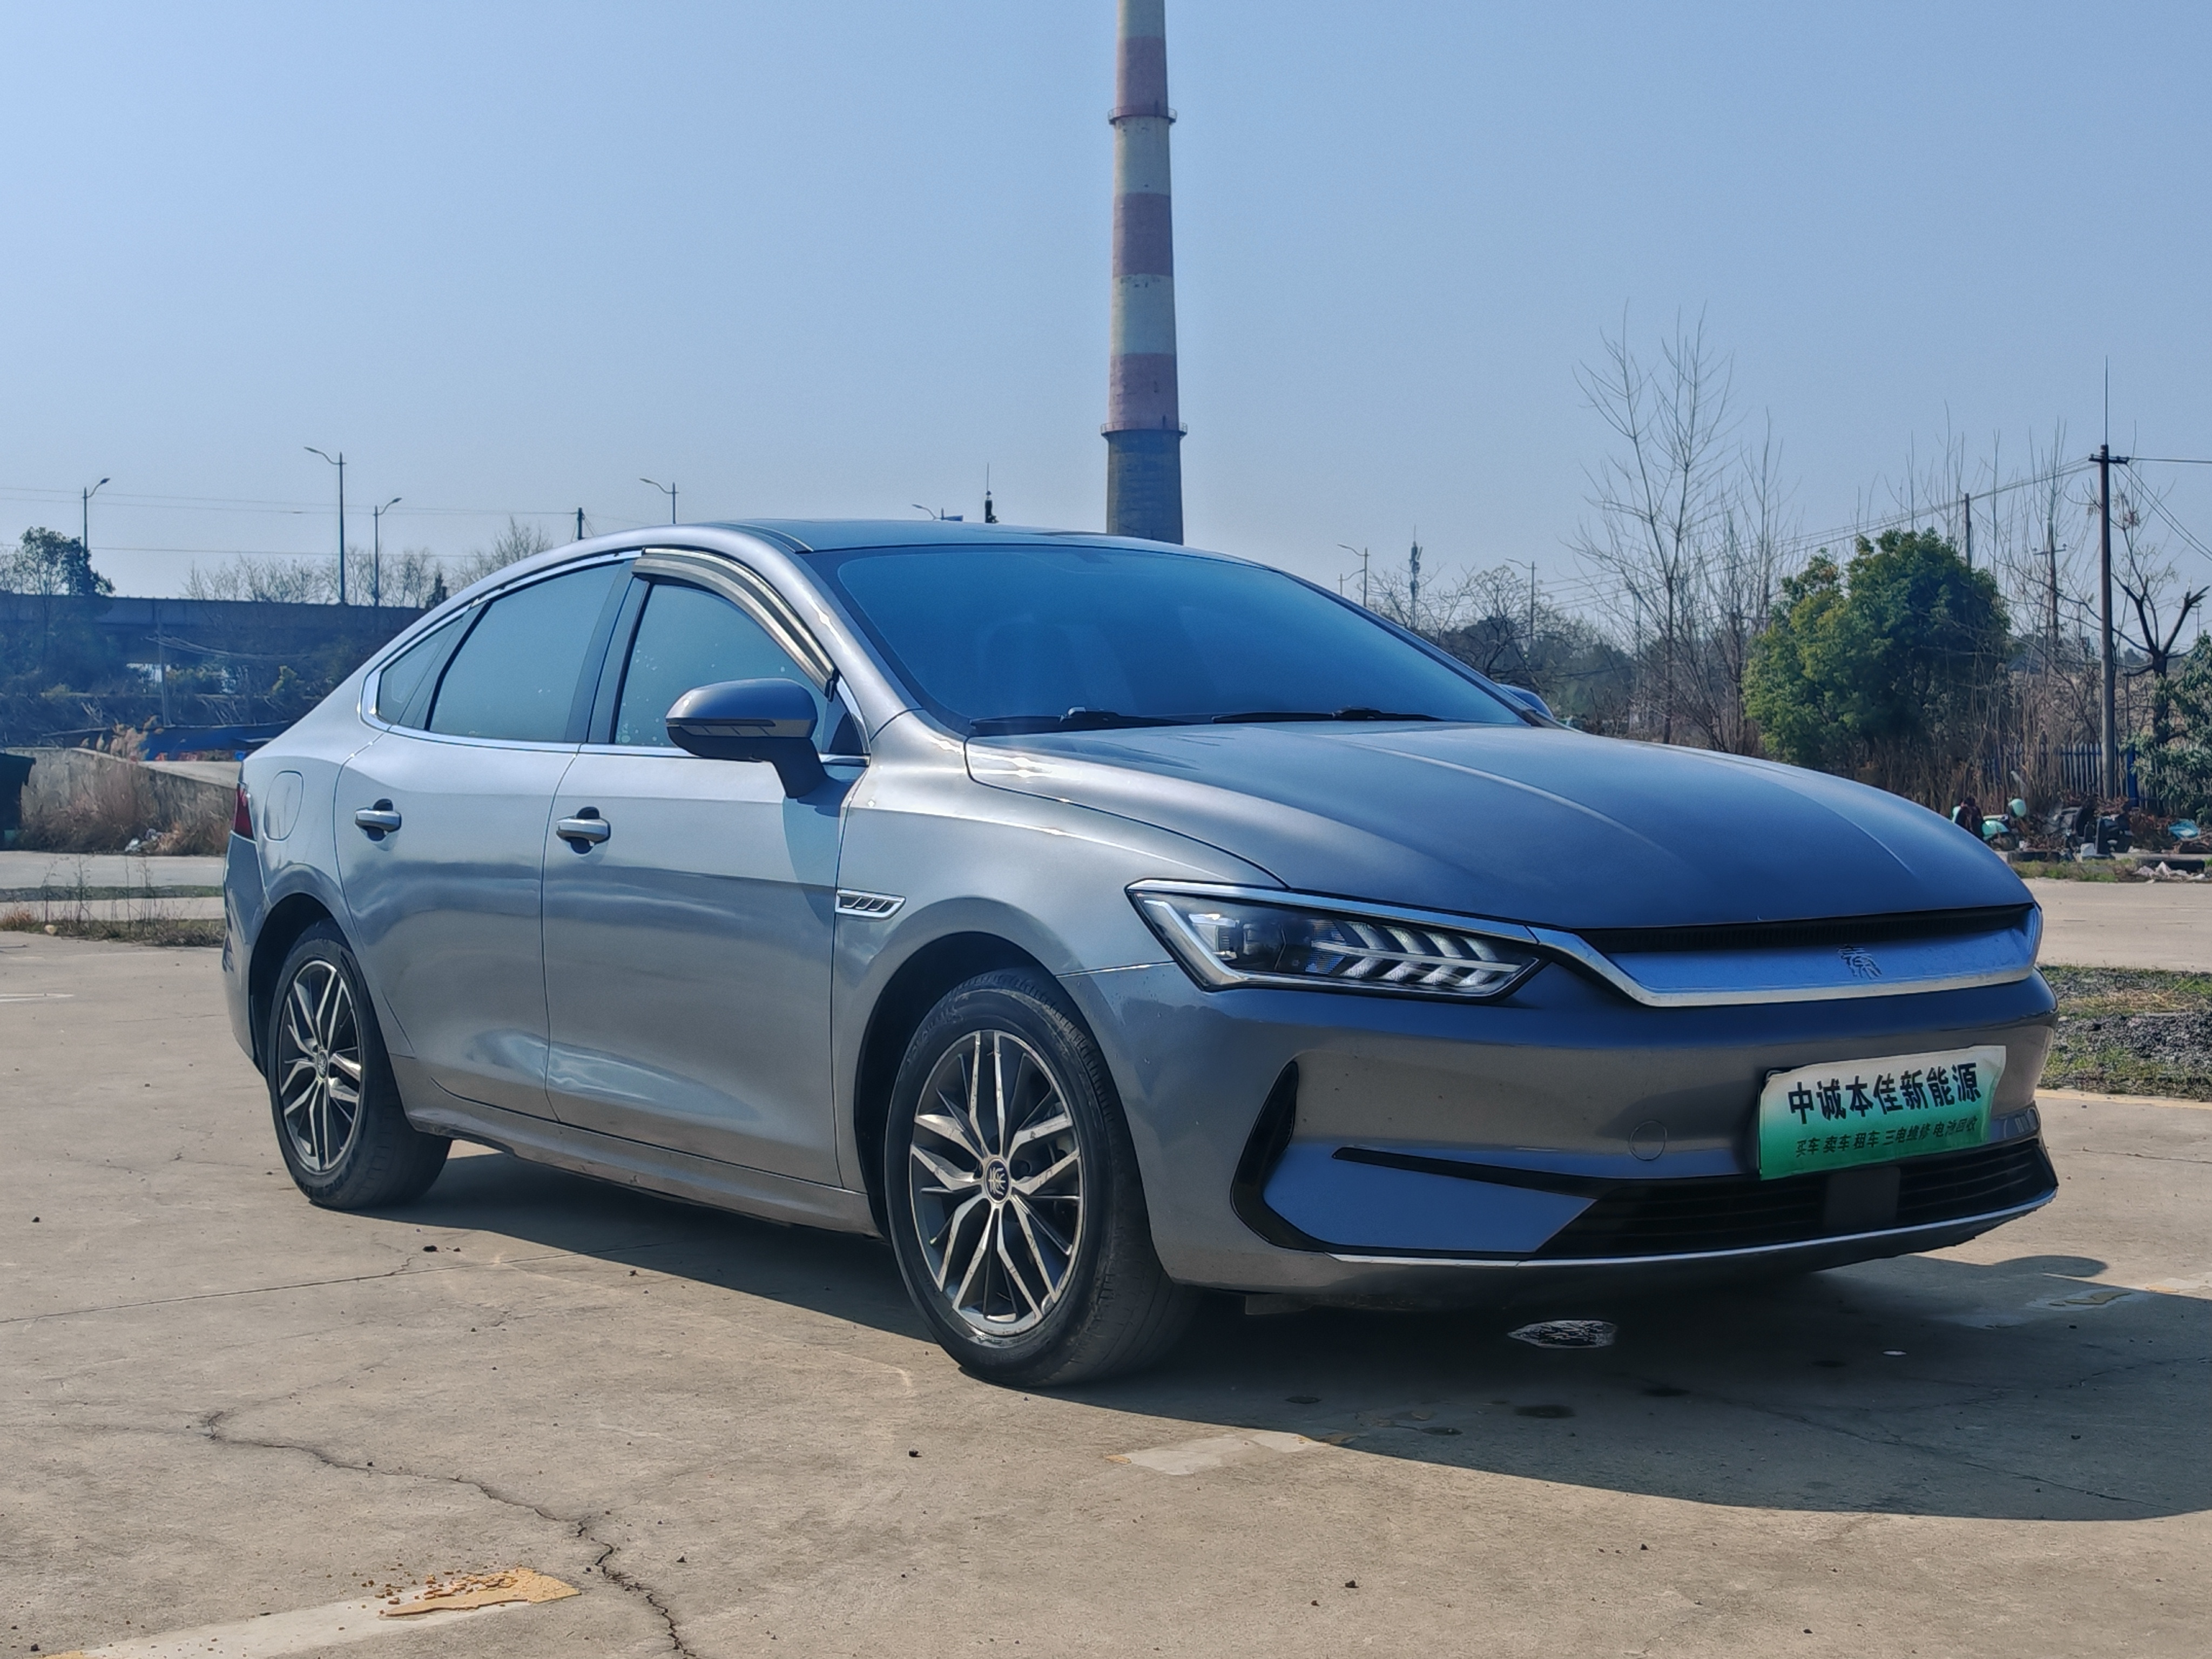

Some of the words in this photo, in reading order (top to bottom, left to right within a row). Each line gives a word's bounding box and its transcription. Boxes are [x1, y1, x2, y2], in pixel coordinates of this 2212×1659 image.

[1788, 1062, 1982, 1124] 中诚本佳新能源
[1796, 1137, 1820, 1158] 买车
[1823, 1134, 1851, 1154] 卖车
[1853, 1130, 1880, 1150] 租车
[1883, 1122, 1931, 1145] 三电维修
[1932, 1115, 1978, 1137] 电池回收
